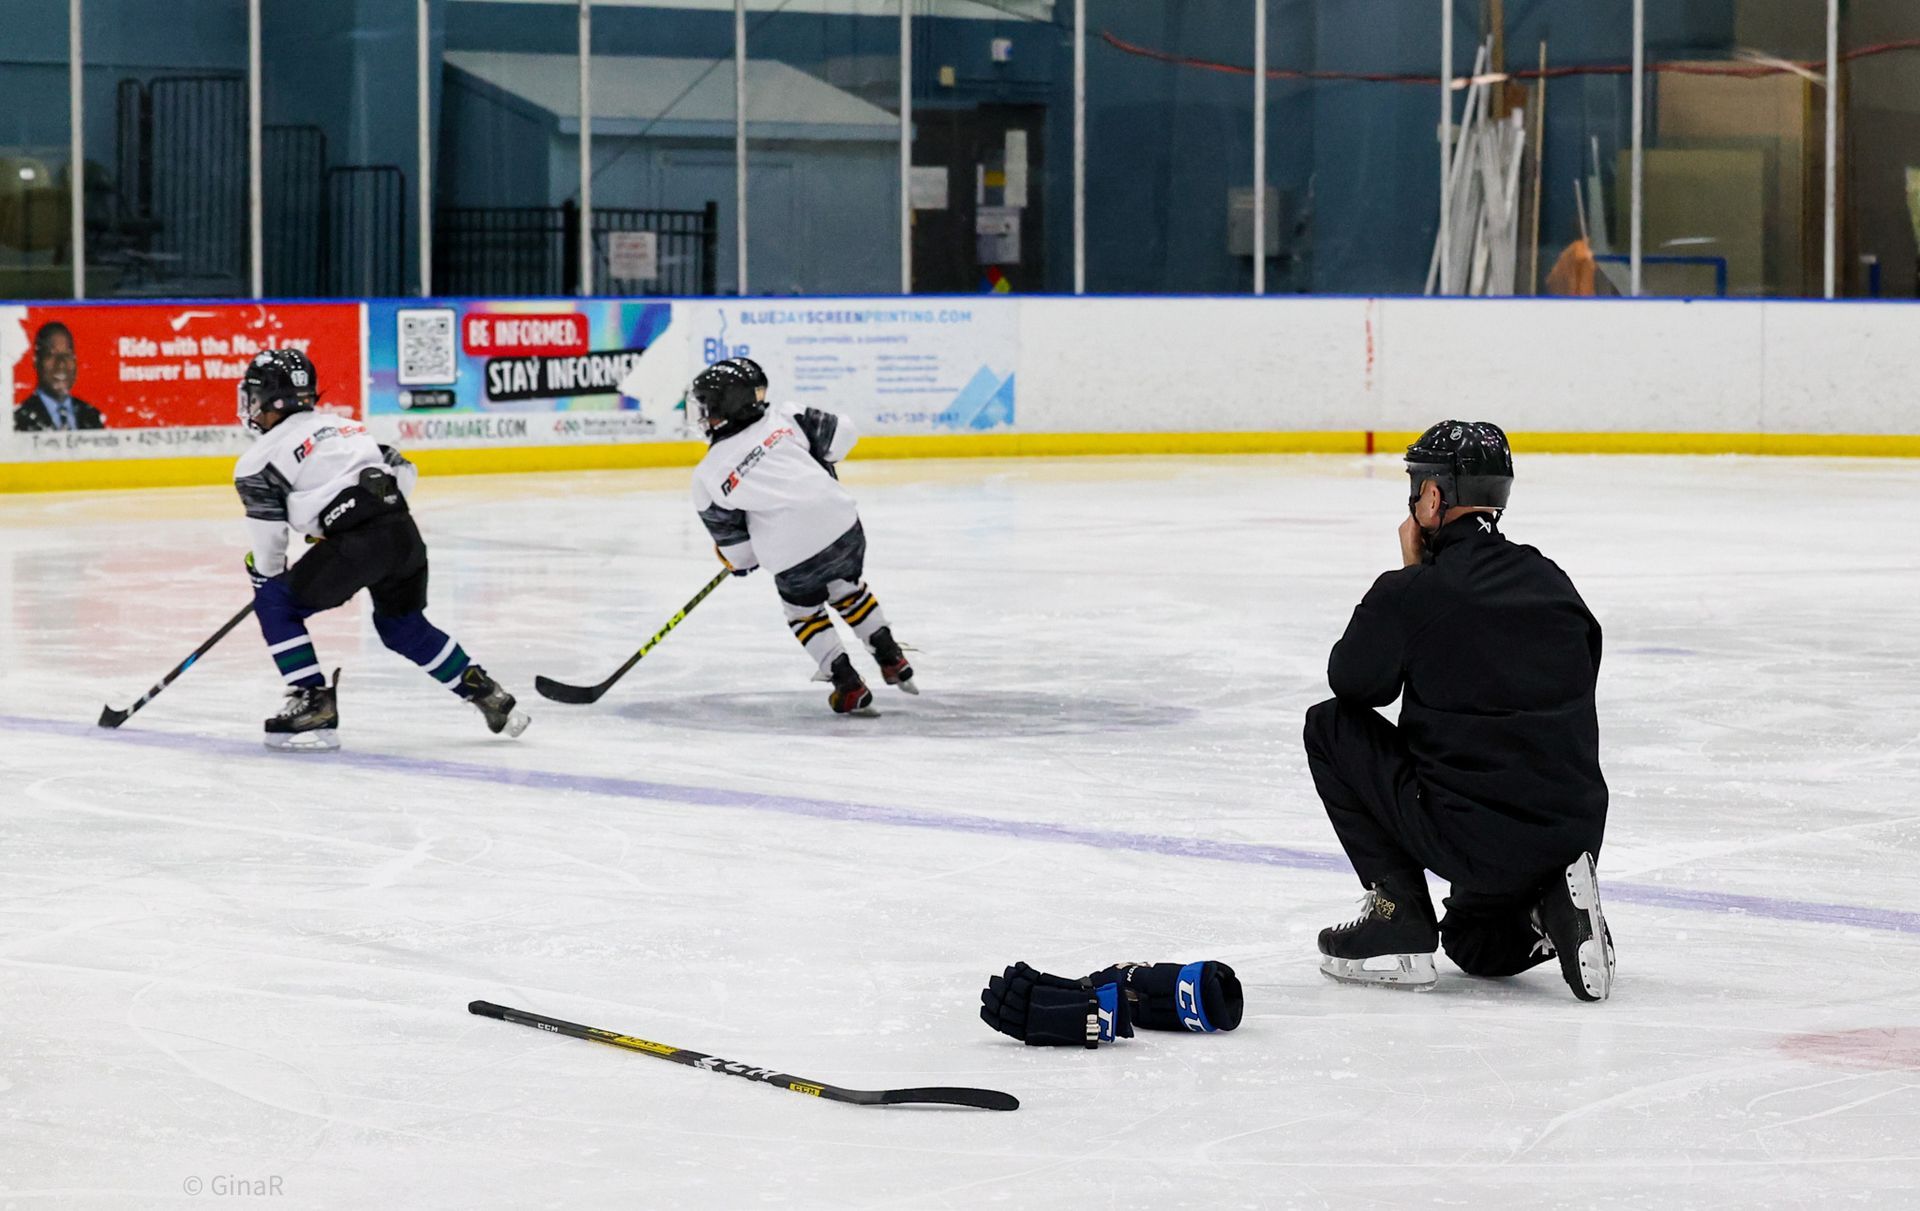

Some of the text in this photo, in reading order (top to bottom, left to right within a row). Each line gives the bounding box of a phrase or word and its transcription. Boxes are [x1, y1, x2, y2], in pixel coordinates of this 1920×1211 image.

[468, 317, 582, 347] BE INFORMED.
[118, 335, 158, 358] Ride
[160, 335, 198, 357] with
[201, 335, 230, 356] the
[703, 337, 750, 365] Blue
[119, 360, 181, 382] insurer
[184, 359, 201, 380] in
[488, 358, 541, 395] STAY
[323, 498, 356, 527] CCM
[537, 1021, 559, 1033] CCM
